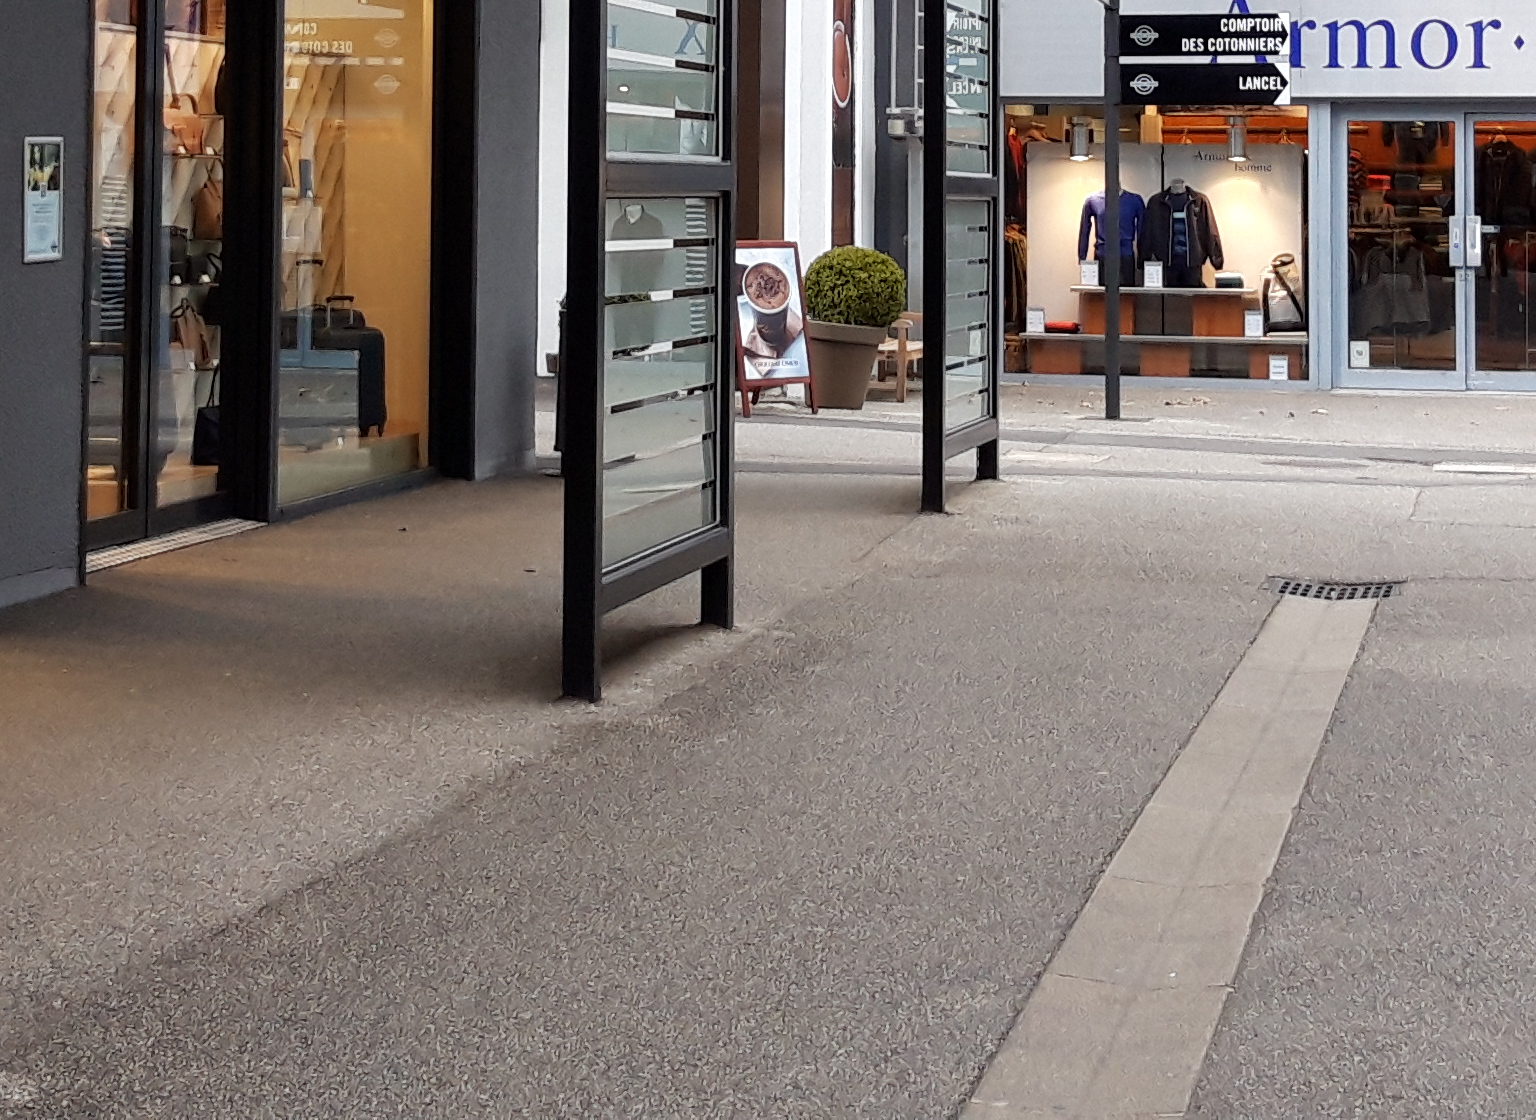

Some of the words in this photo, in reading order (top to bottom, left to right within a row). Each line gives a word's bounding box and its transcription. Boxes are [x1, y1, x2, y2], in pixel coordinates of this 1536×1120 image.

[1220, 17, 1283, 33] COMPTOIR
[1181, 37, 1205, 52] DES
[1207, 37, 1283, 53] COTONNIERS
[1238, 75, 1284, 91] LANCEL
